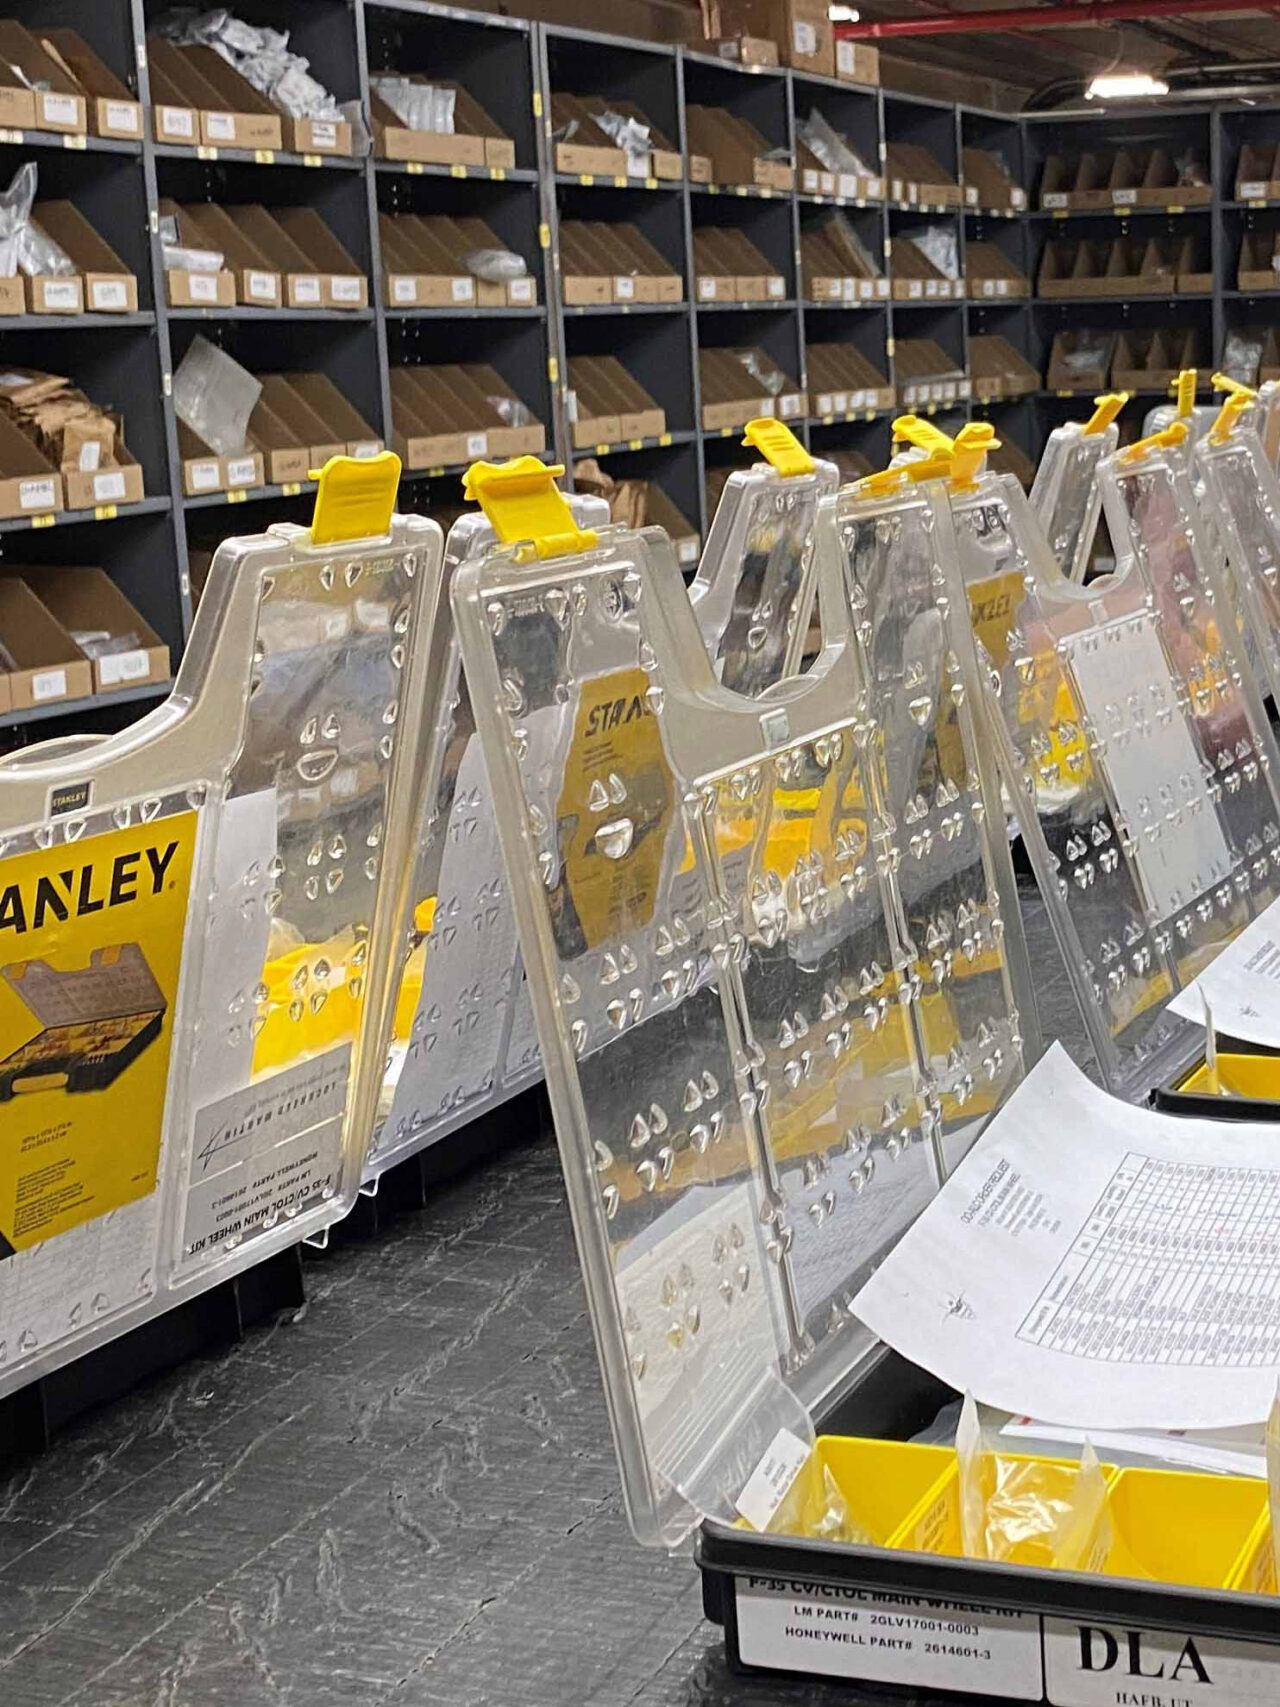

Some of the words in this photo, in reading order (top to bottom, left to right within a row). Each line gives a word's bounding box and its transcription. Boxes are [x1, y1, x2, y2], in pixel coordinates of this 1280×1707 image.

[243, 1206, 270, 1227] MAIN
[208, 1220, 243, 1243] WHEEL
[189, 1238, 206, 1255] KIT
[794, 1605, 812, 1617] LM
[817, 1609, 859, 1622] PART#
[870, 1614, 980, 1637] 2GLV17001-0003
[785, 1626, 867, 1646] HONEYWELL
[870, 1637, 913, 1651] PART#
[924, 1643, 992, 1661] 2614601-3
[1077, 1625, 1214, 1685] DLA
